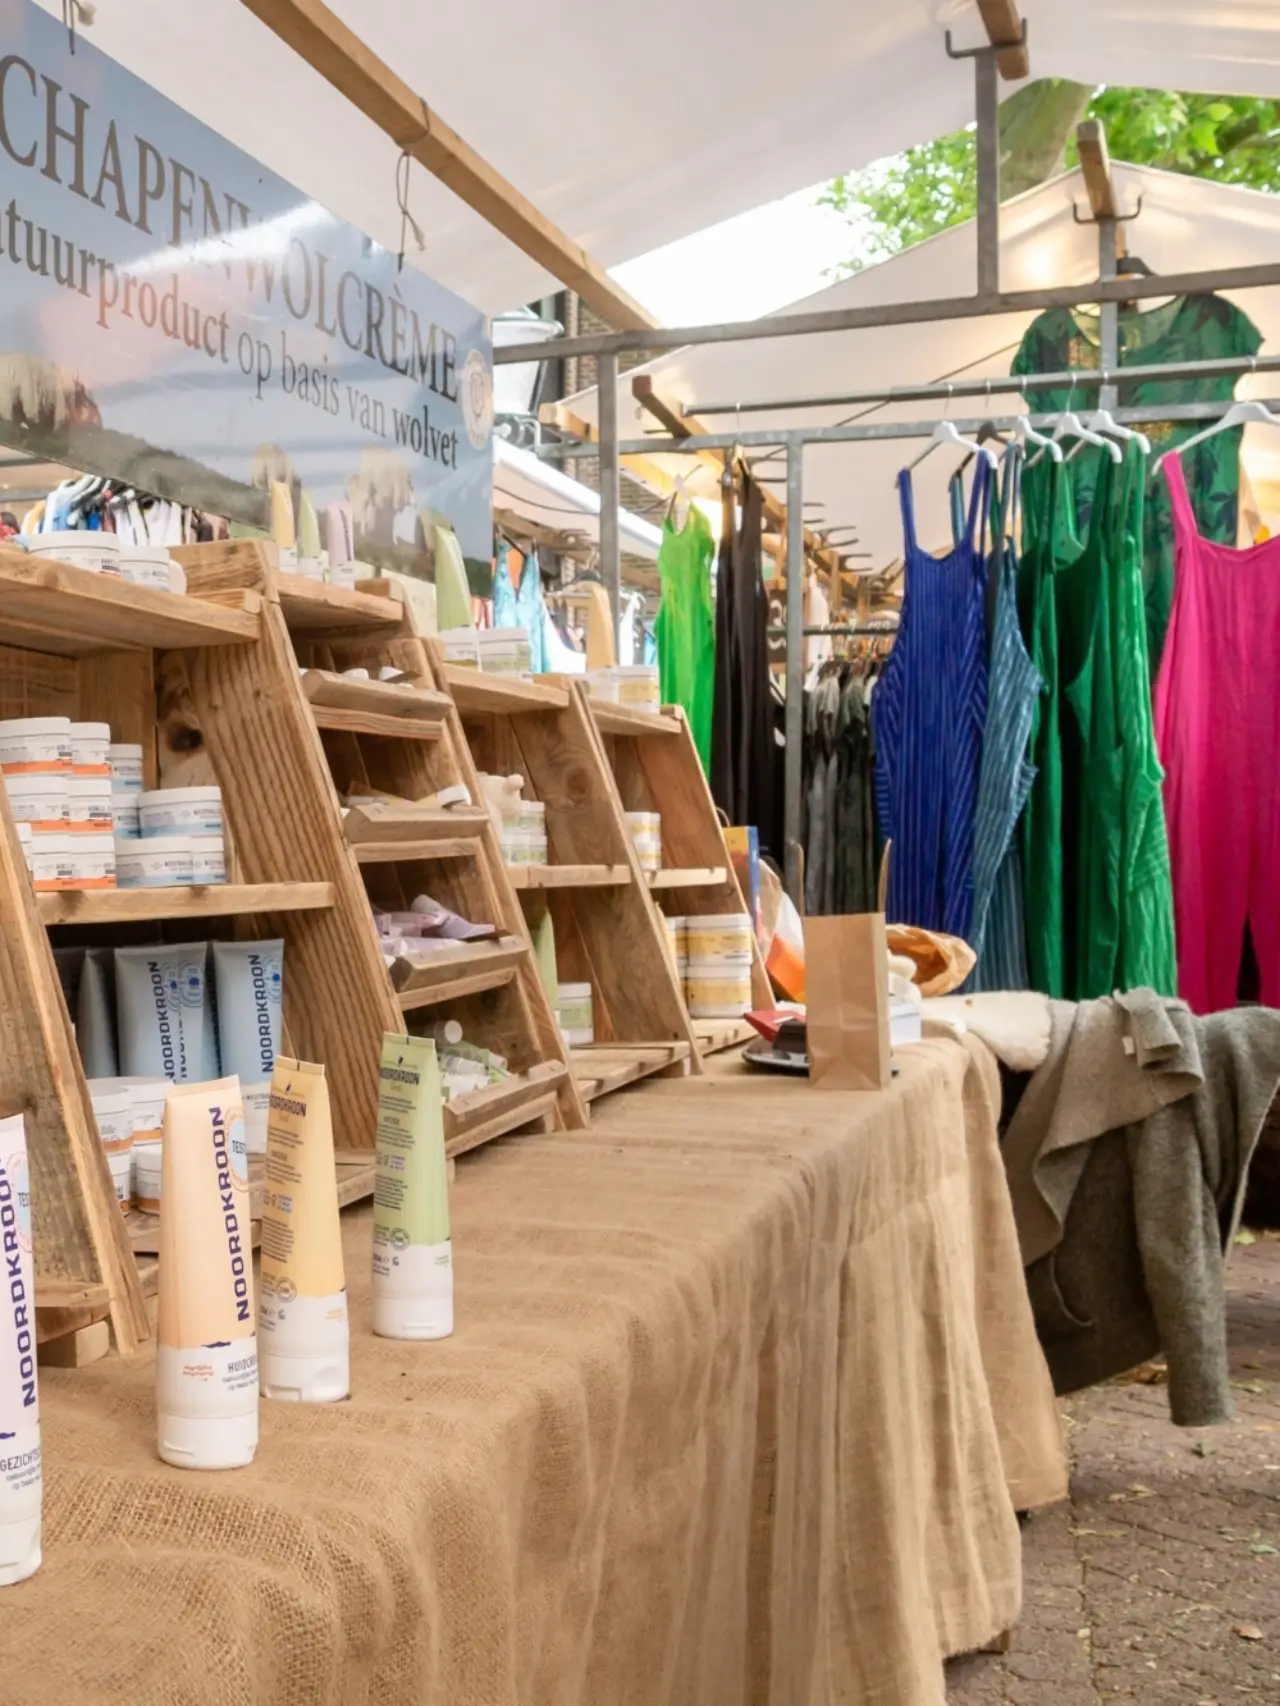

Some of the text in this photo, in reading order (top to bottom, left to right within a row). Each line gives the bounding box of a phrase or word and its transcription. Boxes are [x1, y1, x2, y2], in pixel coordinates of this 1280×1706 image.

[237, 332, 272, 401] op
[280, 330, 340, 417] basis
[346, 384, 388, 439] van
[391, 404, 459, 471] wolvet
[248, 954, 274, 1074] NOORDKROON
[208, 1106, 250, 1322] NOORDKROON
